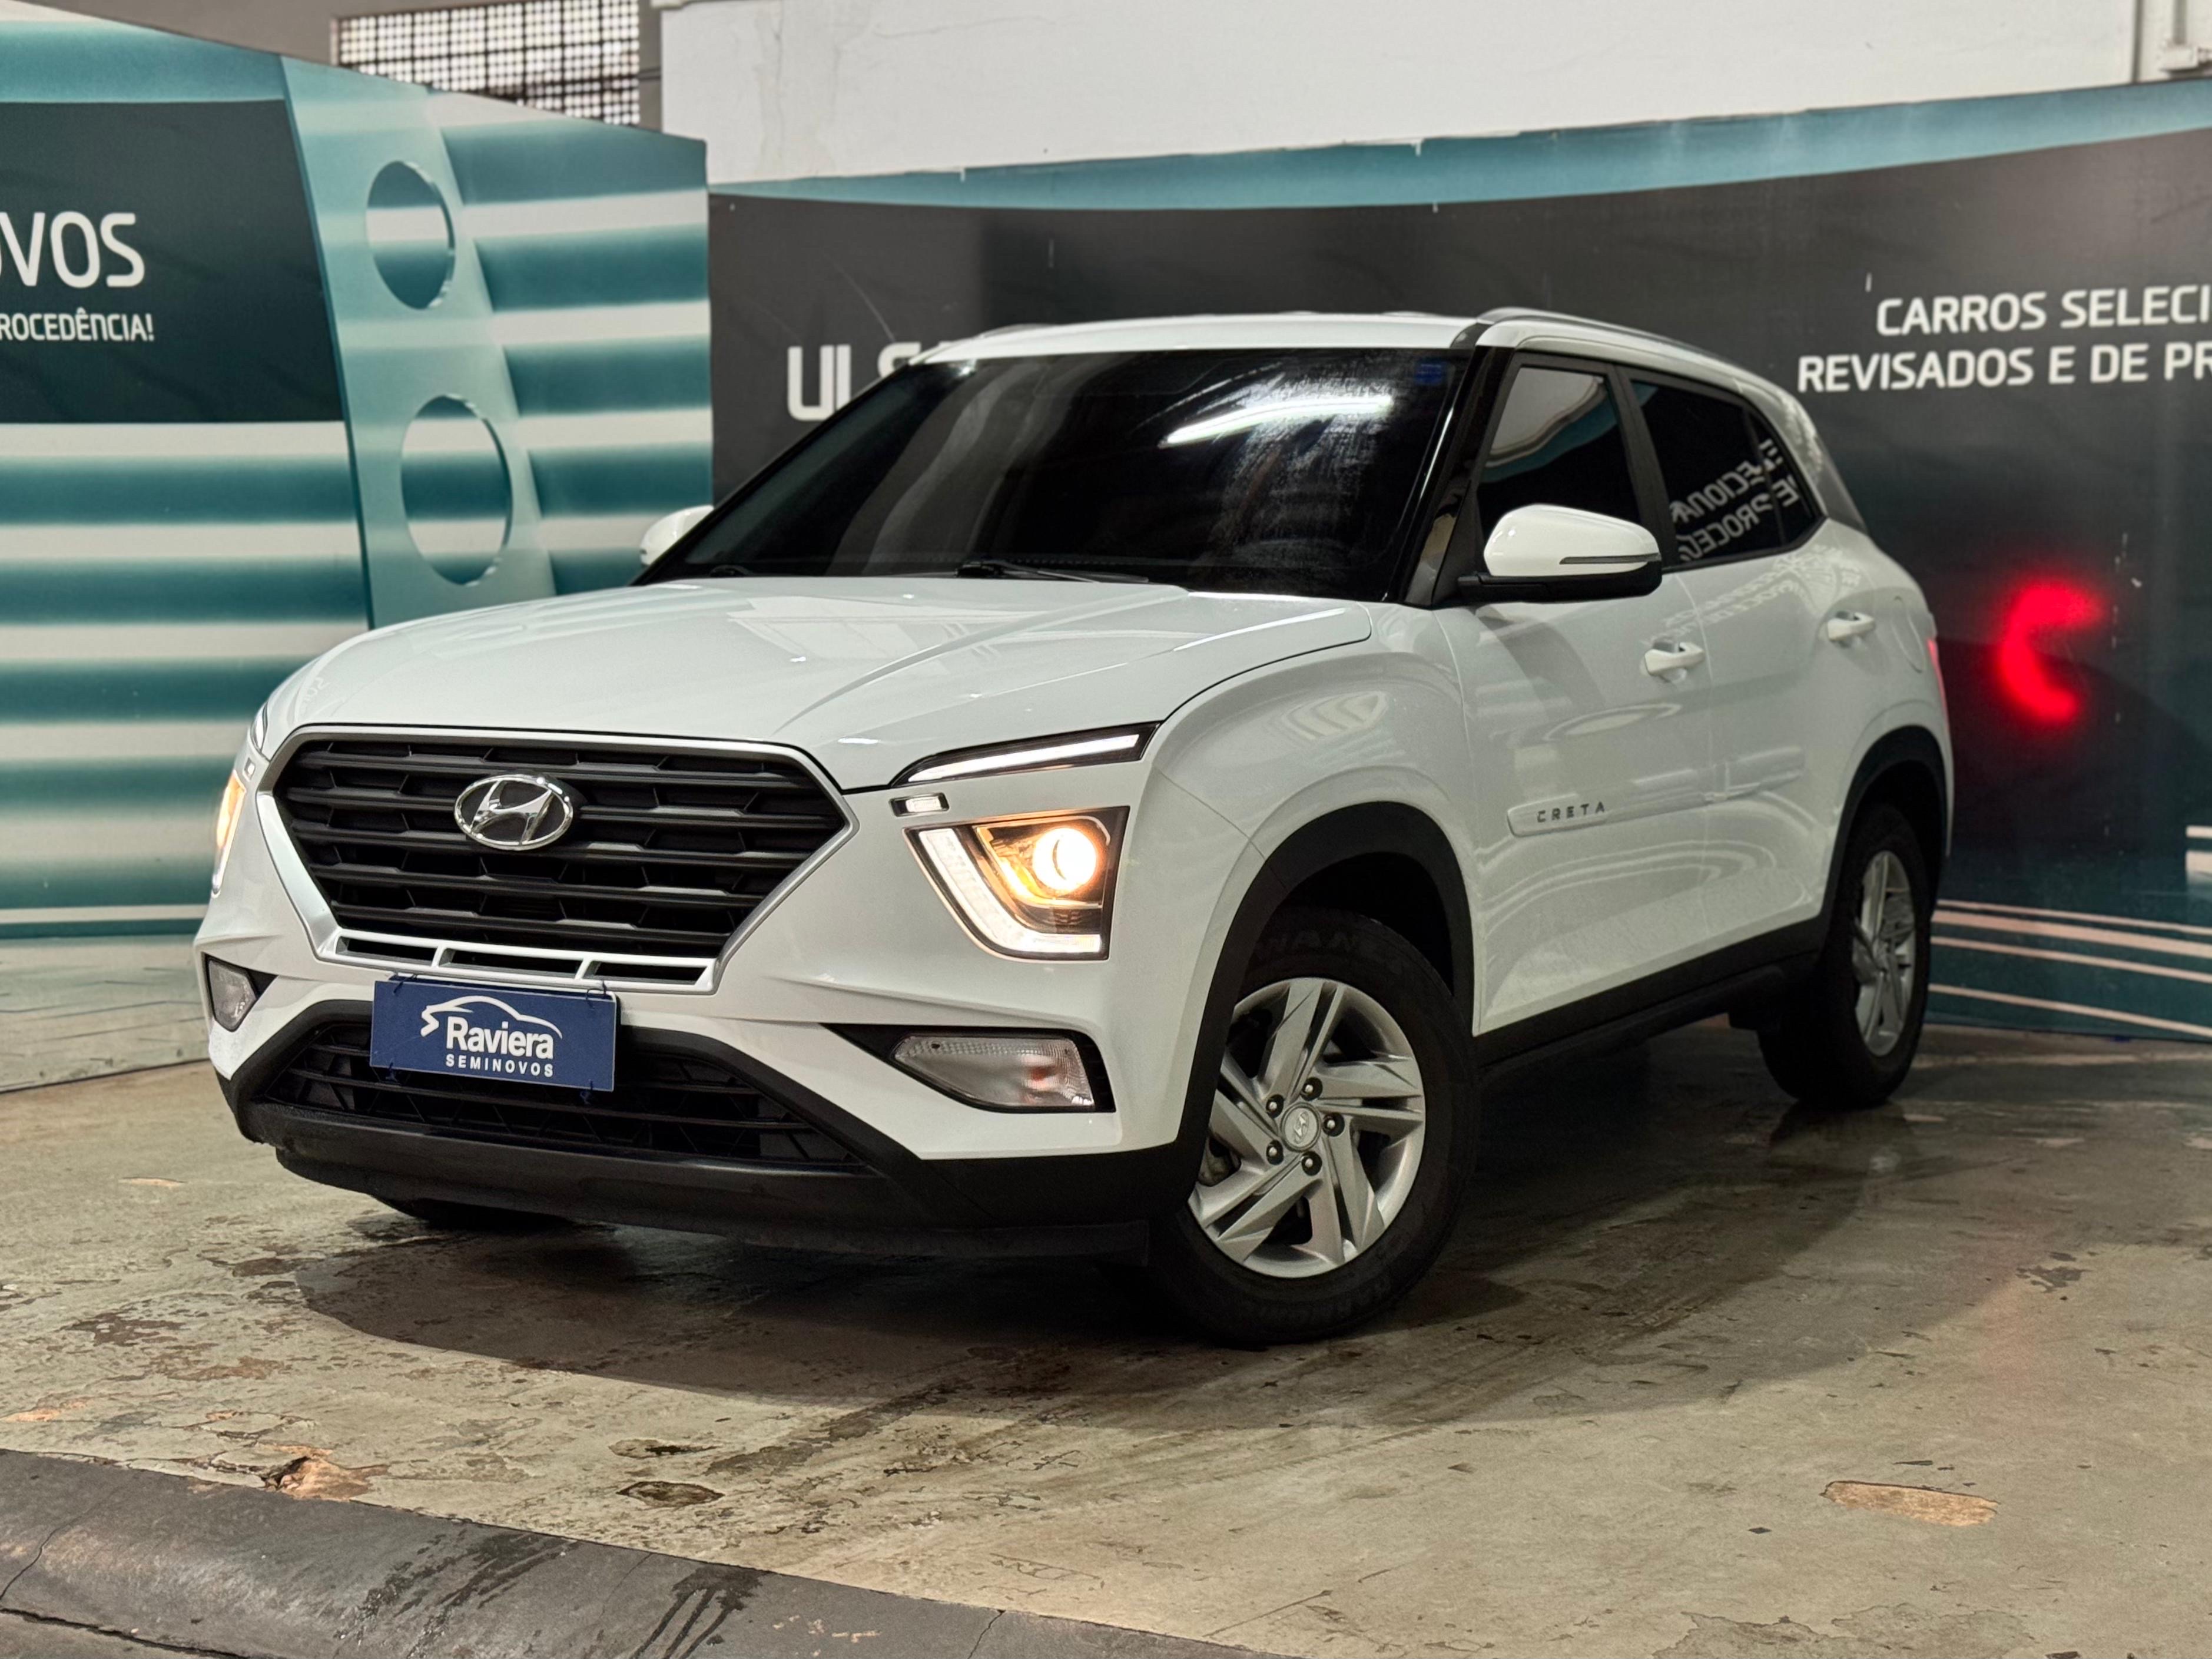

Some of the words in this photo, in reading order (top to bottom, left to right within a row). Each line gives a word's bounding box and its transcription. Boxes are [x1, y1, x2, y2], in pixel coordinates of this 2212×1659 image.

[0, 211, 145, 288] VOS
[1876, 292, 2047, 336] CARROS
[2060, 284, 2211, 329] SELECI
[1798, 347, 2034, 393] REVISADOS
[2048, 346, 2076, 384] E
[2090, 343, 2149, 383] DE
[2164, 340, 2212, 380] PR
[1537, 801, 1606, 823] CRETA
[446, 1015, 554, 1059] Raviera
[445, 1053, 554, 1078] SEMINOVOS
